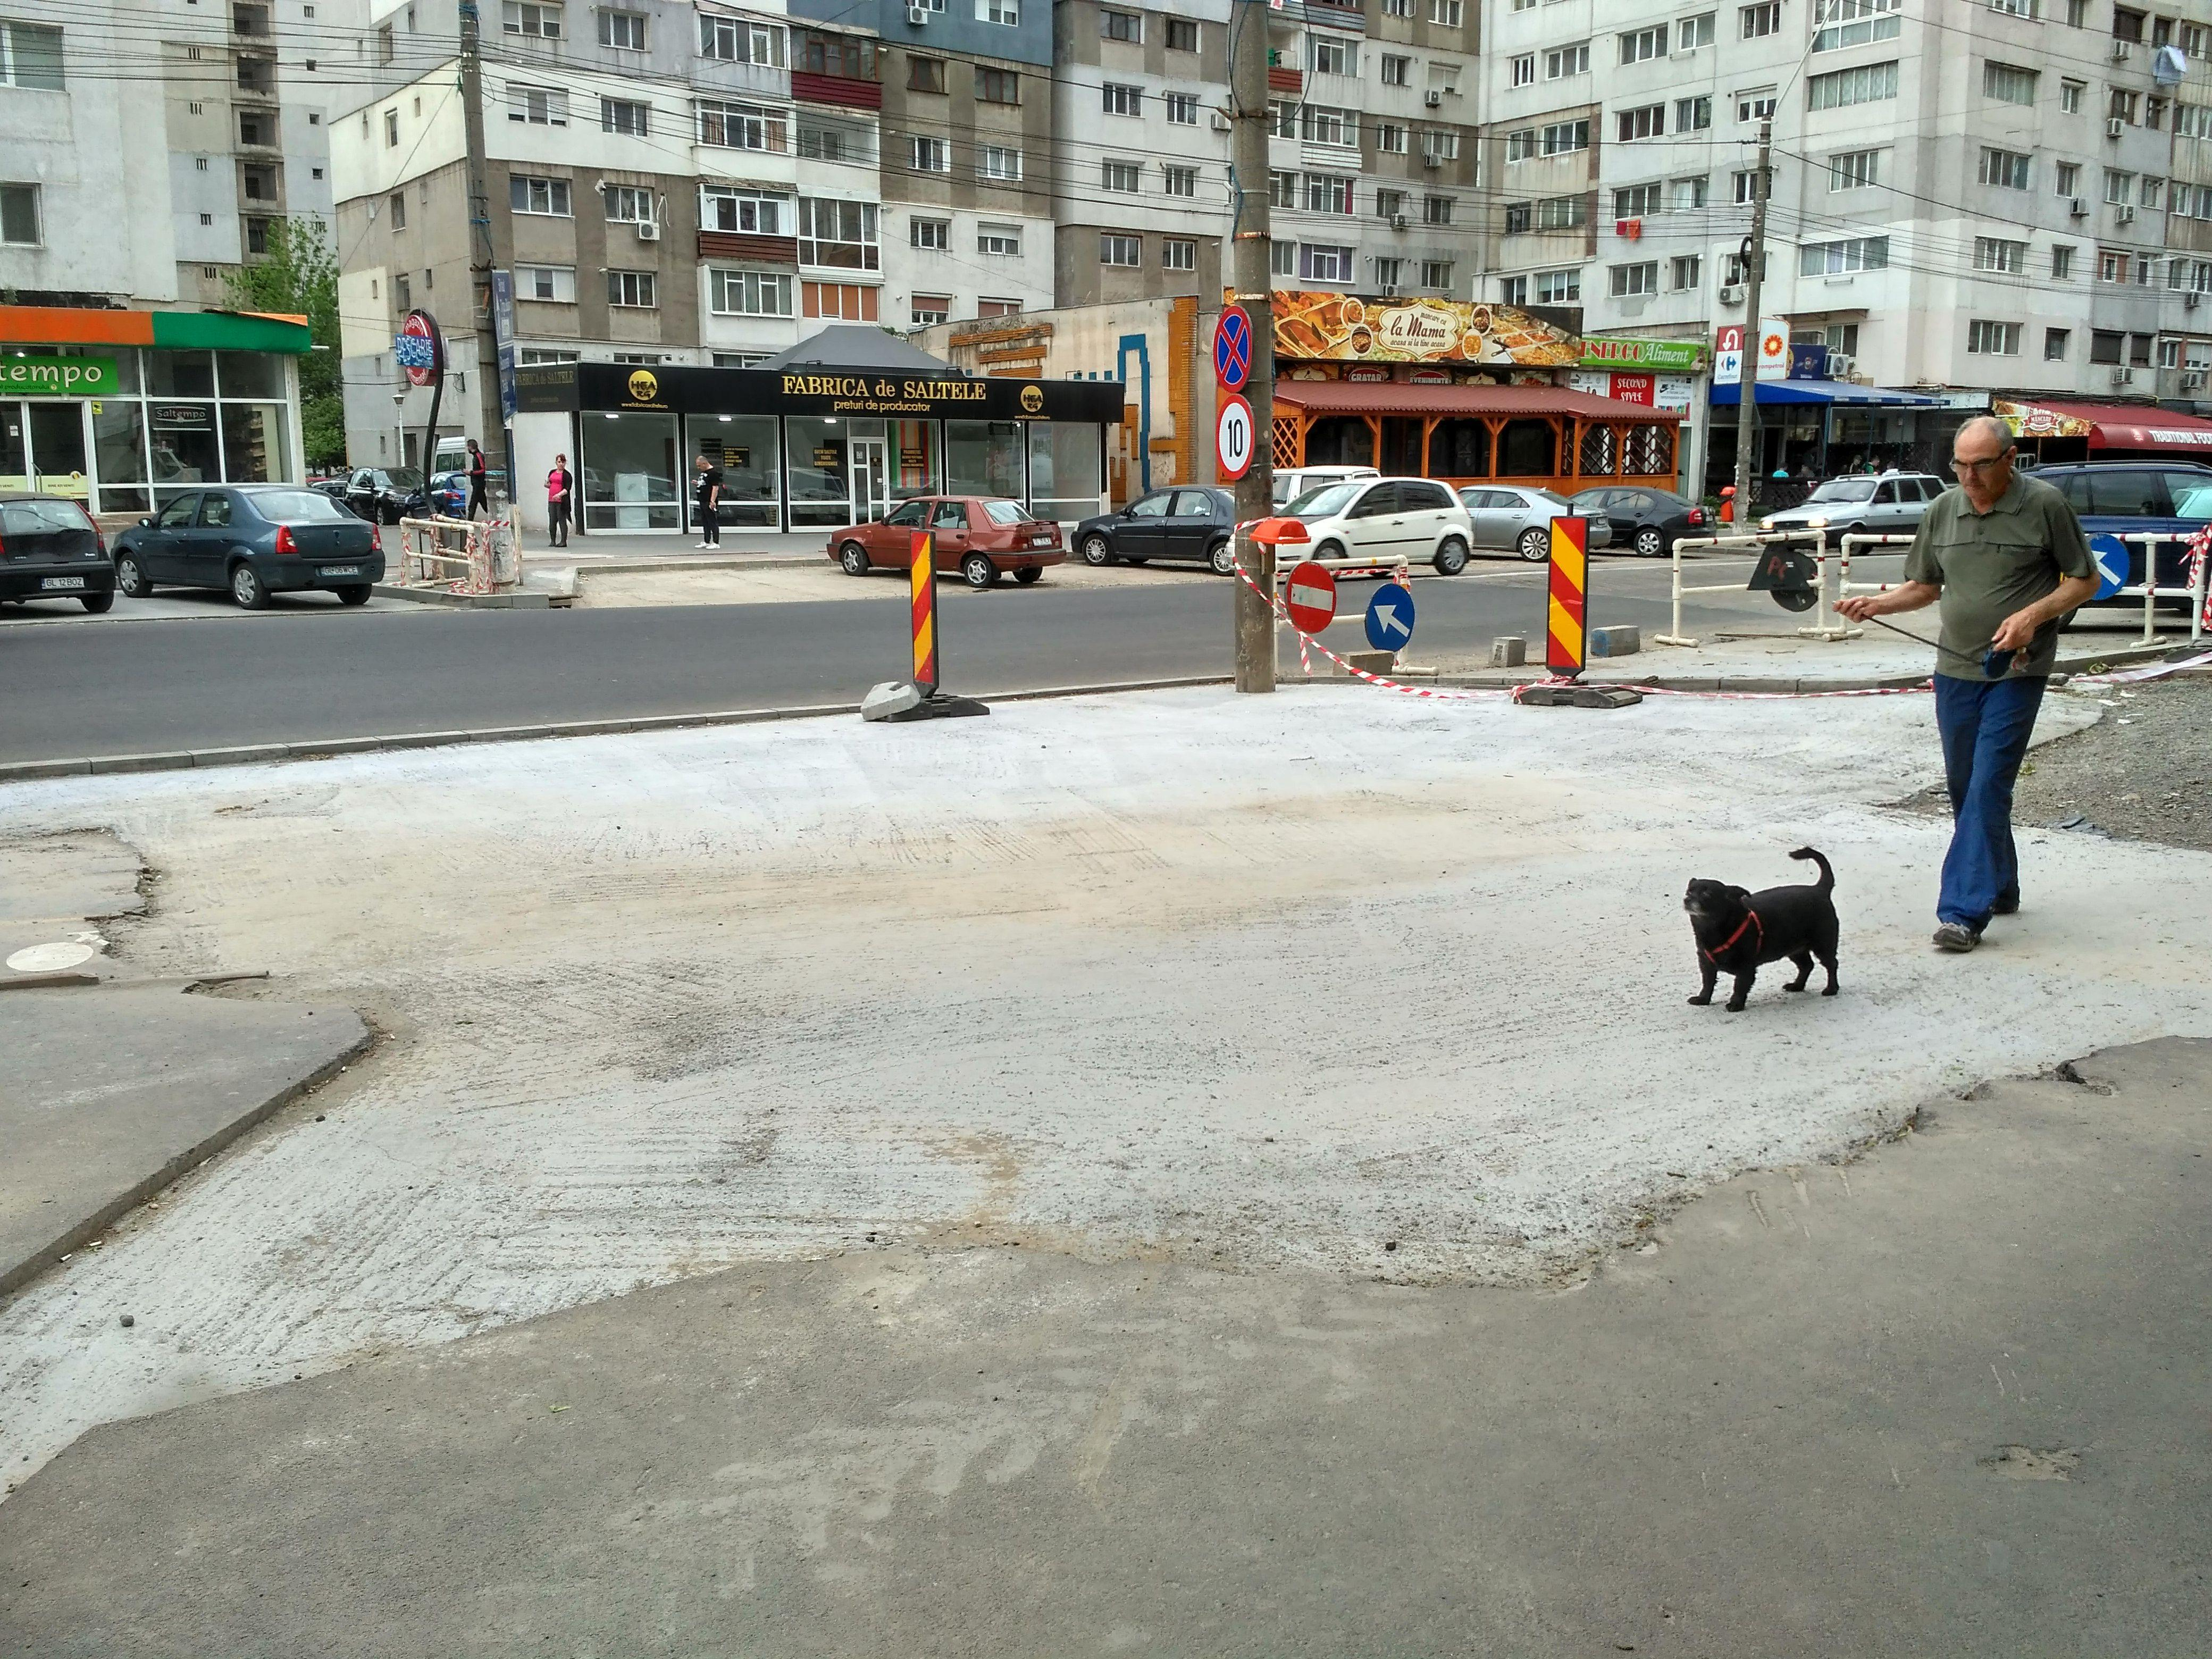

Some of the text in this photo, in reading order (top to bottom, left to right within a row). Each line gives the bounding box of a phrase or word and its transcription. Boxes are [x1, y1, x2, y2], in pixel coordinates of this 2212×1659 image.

[1390, 313, 1446, 338] la Mama
[1640, 342, 1689, 363] Aliment
[782, 375, 986, 400] FABRICA de SALTELE
[1617, 378, 1647, 389] SECOND
[1620, 392, 1643, 403] STYLE
[834, 400, 931, 413] preturi de producator
[156, 409, 206, 419] Saltempo
[1228, 418, 1243, 457] 10
[2148, 430, 2198, 444] TRADITIONAL
